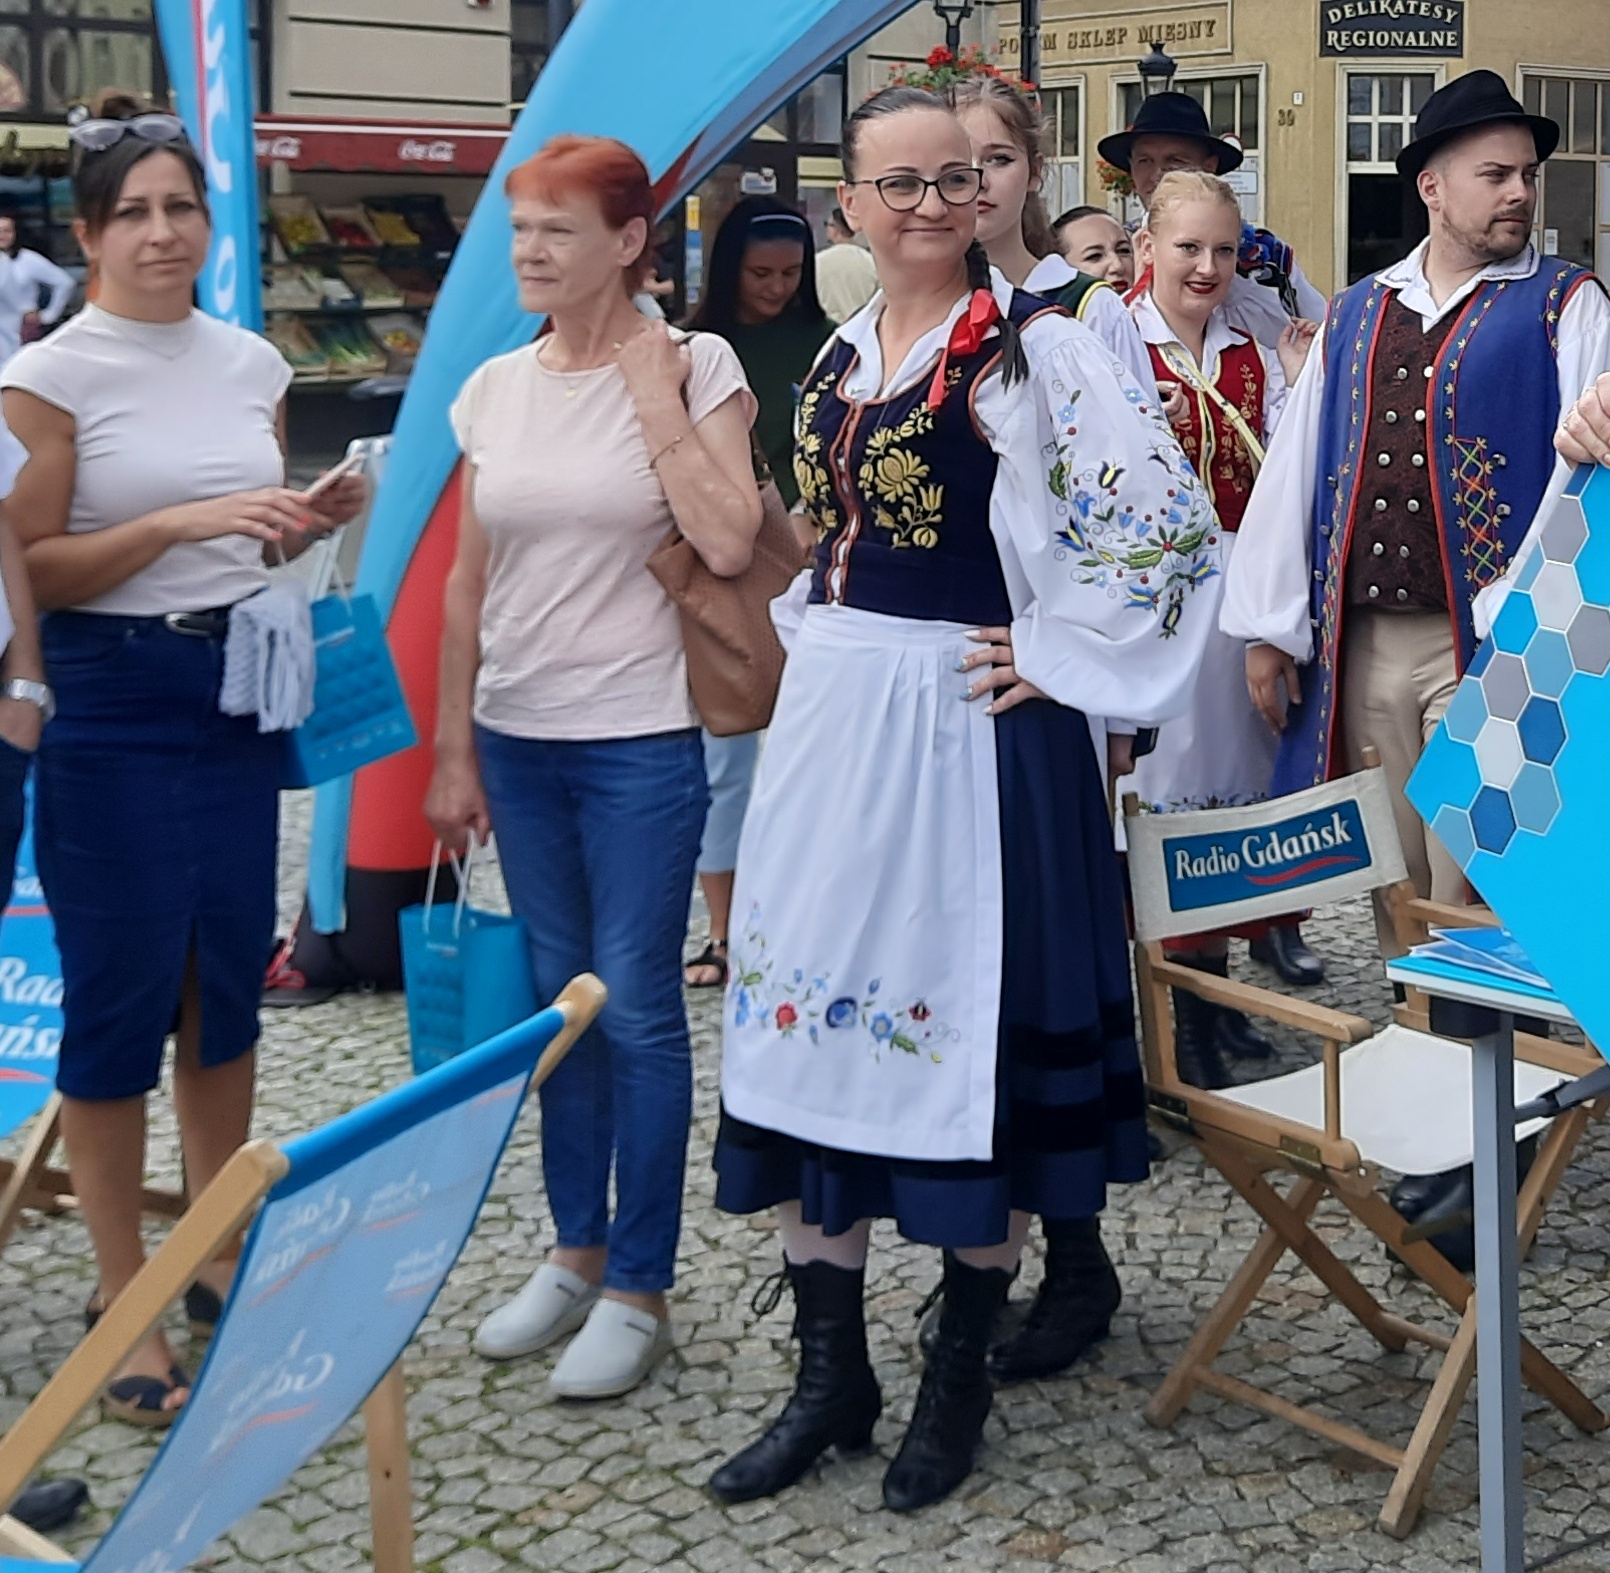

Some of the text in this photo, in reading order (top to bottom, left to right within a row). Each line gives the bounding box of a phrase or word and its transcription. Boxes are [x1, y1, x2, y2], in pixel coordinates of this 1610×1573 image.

[1327, 0, 1459, 24] DELIKATESY
[1067, 27, 1127, 49] SKLEP
[1327, 30, 1458, 51] REGIONALNE
[1174, 811, 1352, 880] Radio Gdańsk
